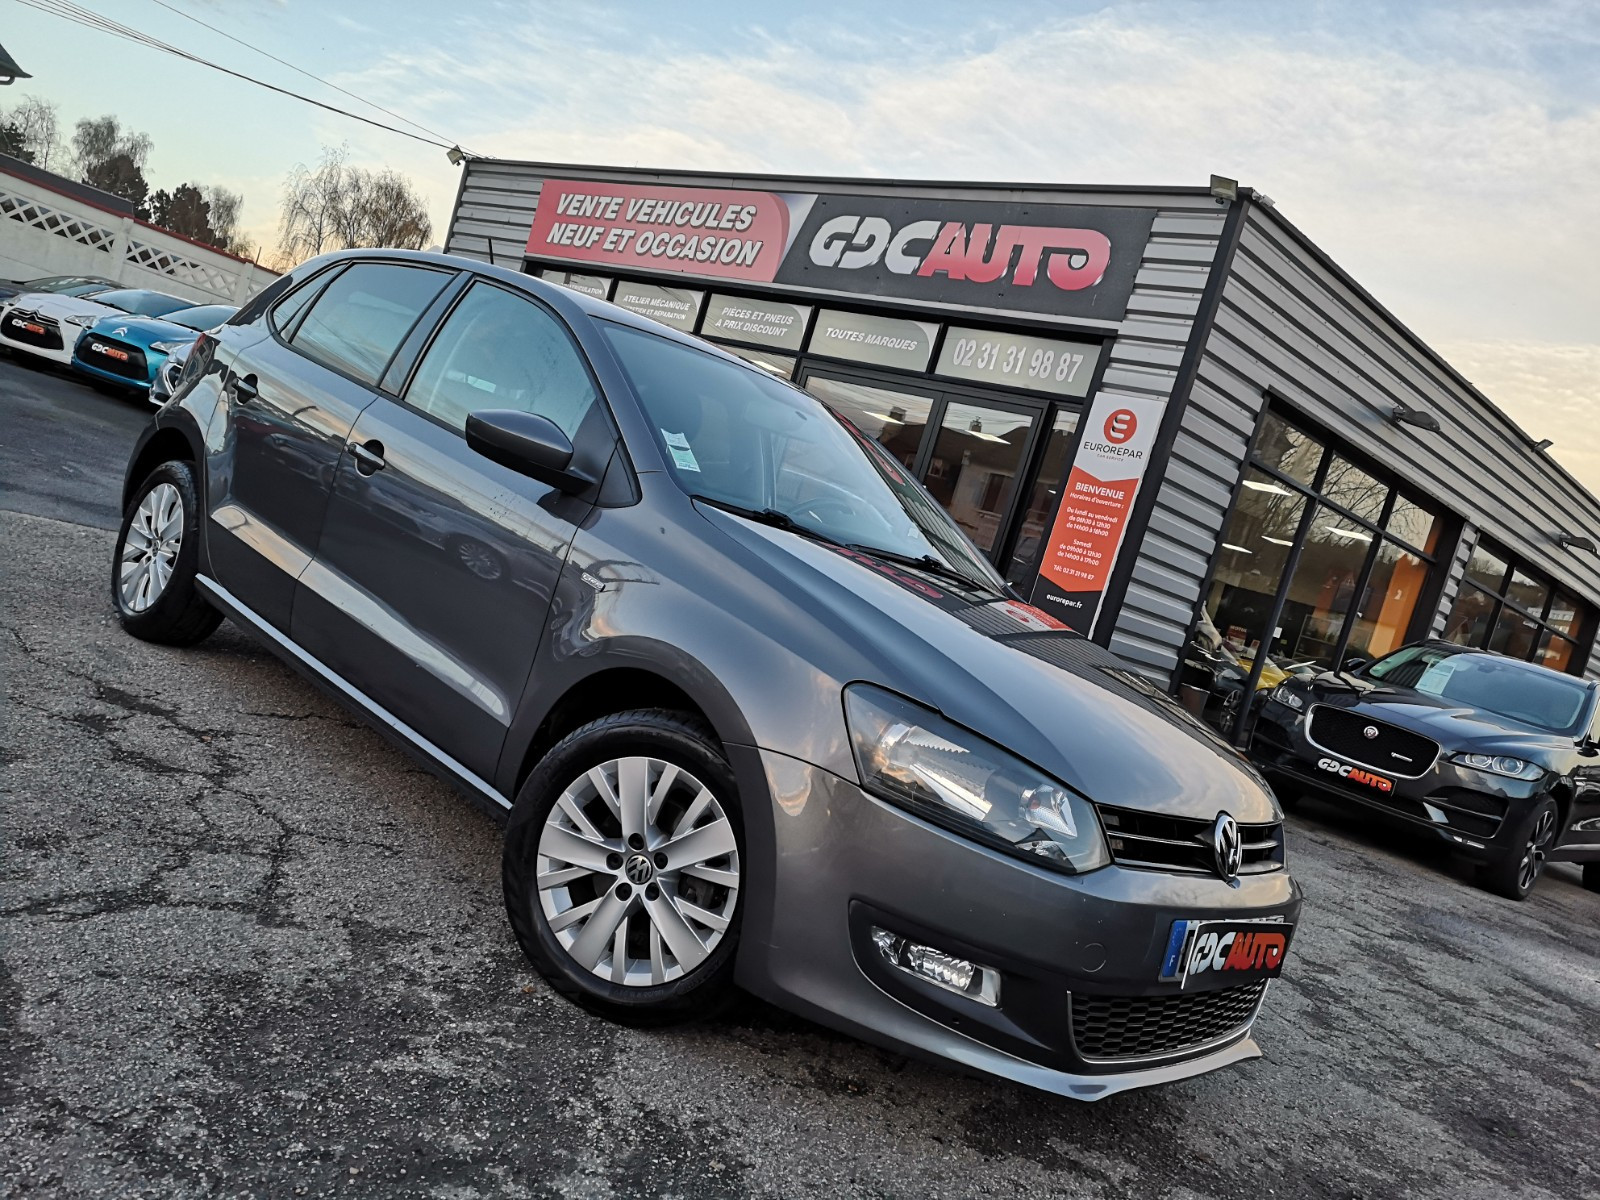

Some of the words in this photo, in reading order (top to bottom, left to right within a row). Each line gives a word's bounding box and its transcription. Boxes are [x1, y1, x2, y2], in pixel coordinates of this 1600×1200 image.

[556, 193, 625, 219] VENTE
[625, 199, 757, 231] VEHICULES
[546, 223, 604, 247] NEUF
[603, 228, 634, 251] ET
[635, 231, 763, 266] OCCASION
[623, 295, 650, 305] ATELIER
[650, 297, 690, 311] MÉCANIQUE
[721, 307, 752, 320] PIÈCES
[751, 311, 764, 321] ET
[763, 313, 794, 325] PNEUS
[715, 319, 723, 327] A
[723, 320, 743, 330] PRIX
[743, 322, 787, 337] DISCOUNT
[825, 328, 863, 342] TOUTES
[864, 333, 917, 351] MARQUES
[953, 338, 976, 366] 02
[977, 343, 1001, 370] 31
[1002, 347, 1027, 375] 31
[1028, 349, 1053, 380] 98
[1055, 354, 1084, 384] 87
[1084, 441, 1143, 459] EUROREPAR
[1070, 492, 1090, 502] Horaires
[1091, 496, 1121, 508] d'ouverture
[1075, 482, 1125, 500] BIENVENUE
[1075, 508, 1088, 516] lundi
[1095, 513, 1118, 523] vendredi
[1073, 539, 1092, 548] Samedi
[1046, 593, 1083, 609] eurorepar.fr
